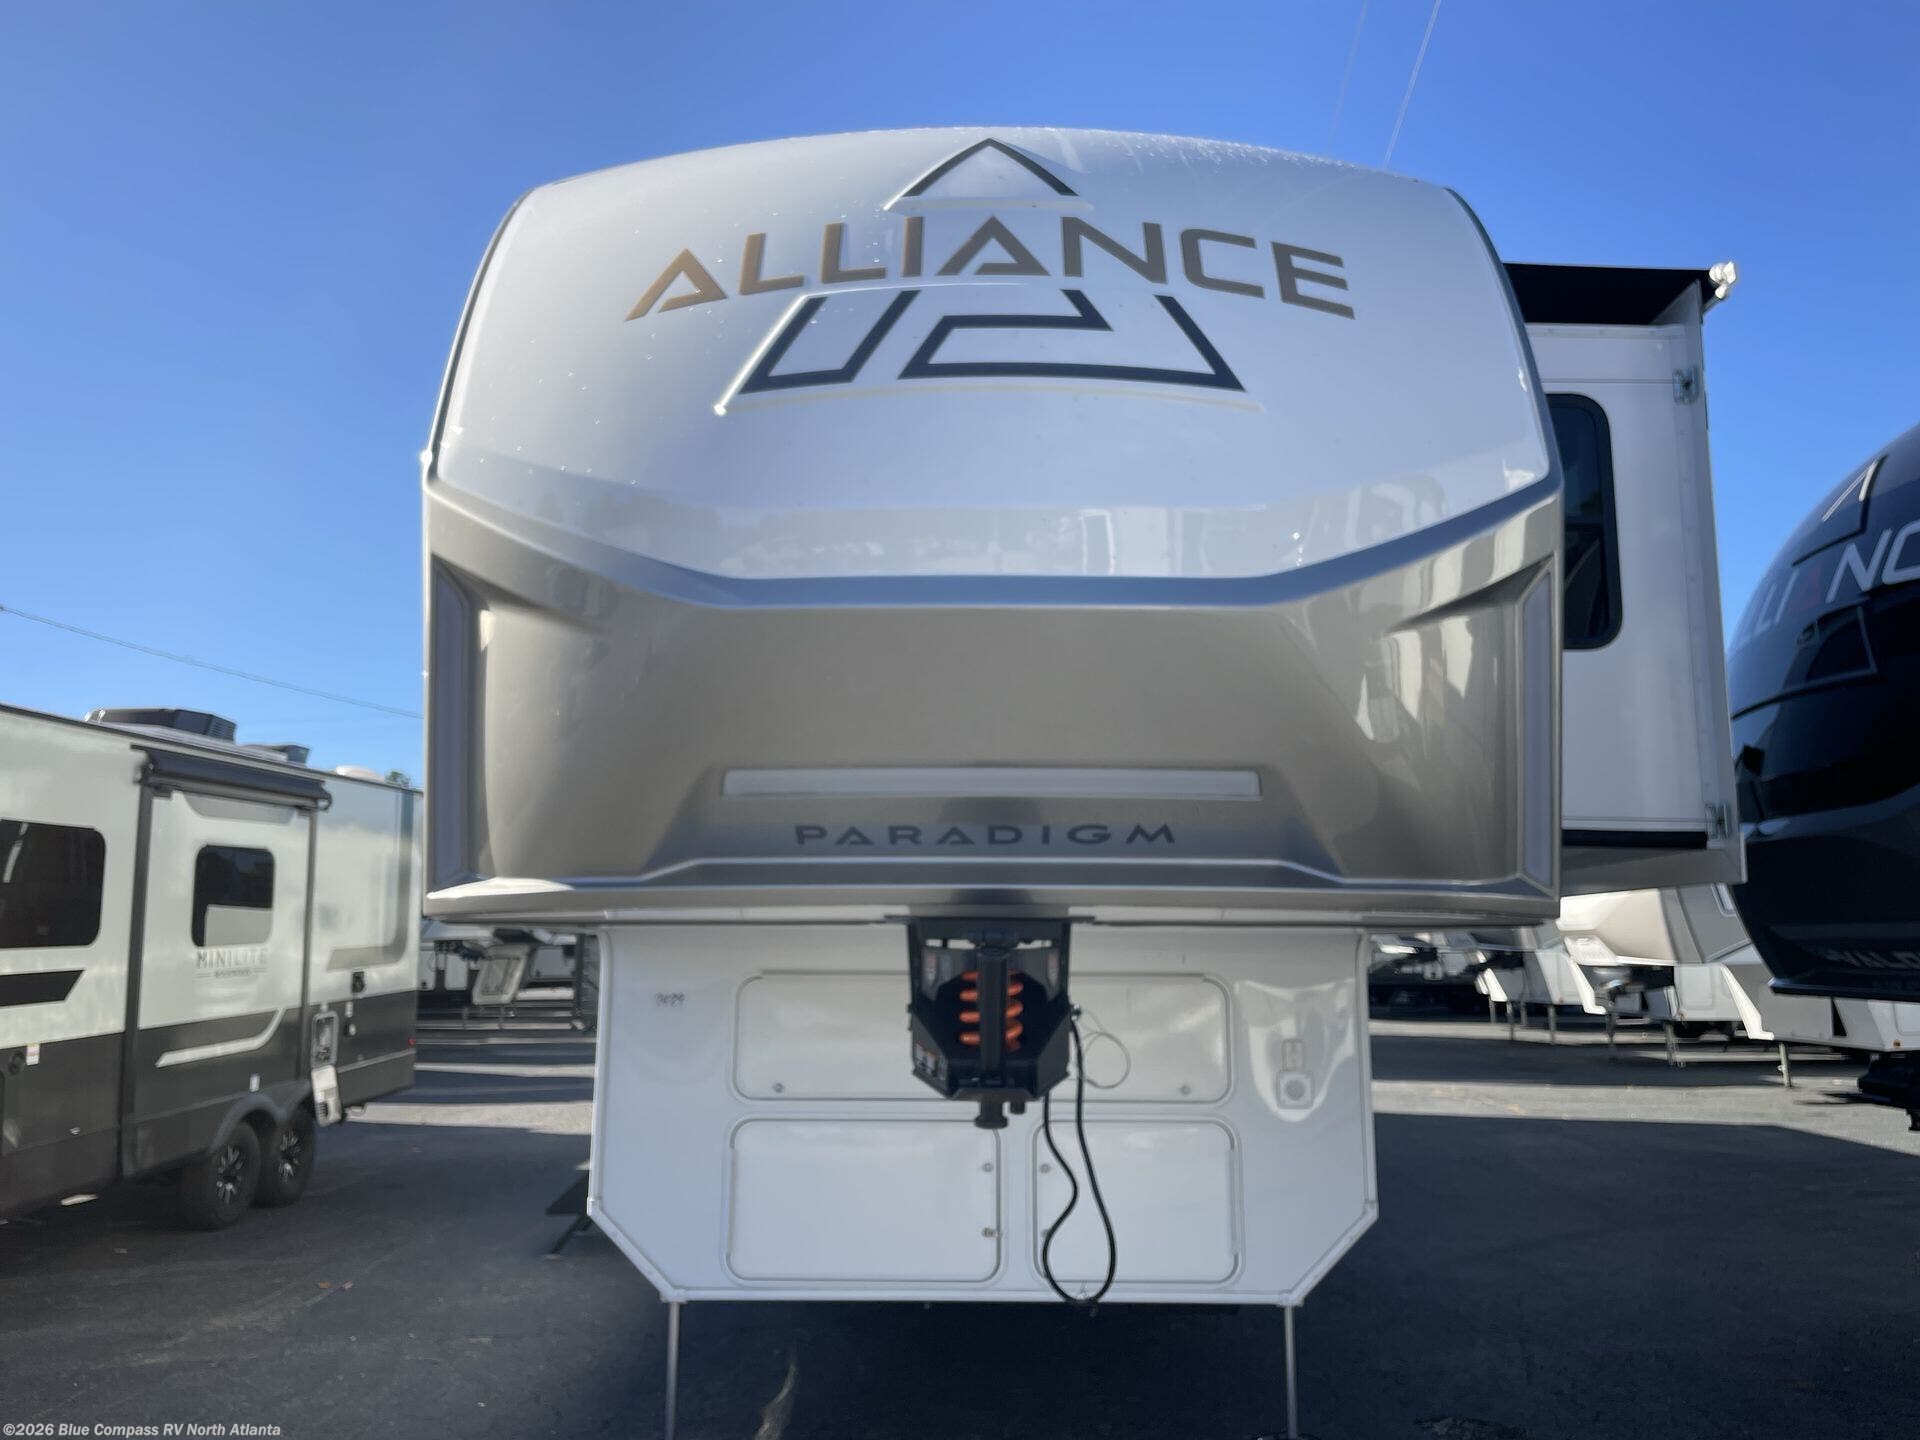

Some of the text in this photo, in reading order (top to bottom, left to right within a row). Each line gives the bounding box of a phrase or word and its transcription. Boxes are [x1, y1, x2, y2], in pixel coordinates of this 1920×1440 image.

[625, 216, 1356, 320] ALLIANCE
[794, 823, 1177, 846] PARADIGM
[196, 948, 268, 969] MINILITE
